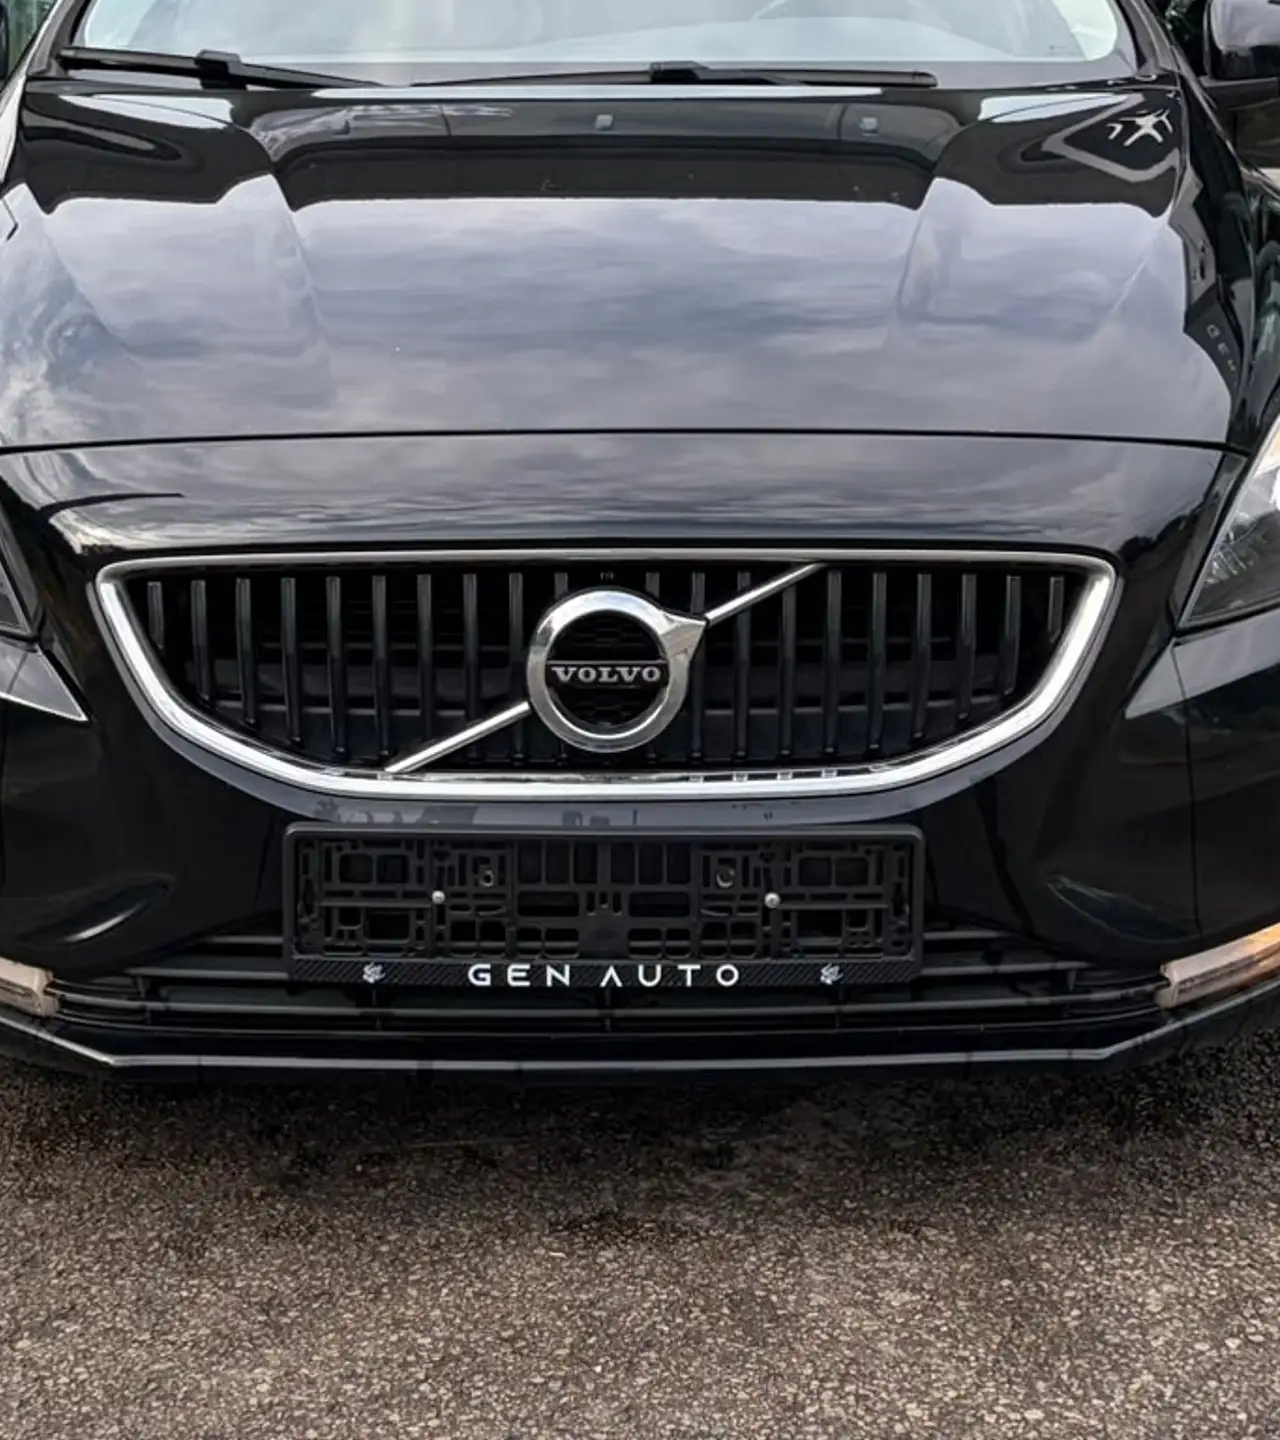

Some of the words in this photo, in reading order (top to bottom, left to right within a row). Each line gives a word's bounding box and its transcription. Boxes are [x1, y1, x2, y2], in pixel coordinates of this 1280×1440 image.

[551, 665, 662, 683] VOLVO
[466, 962, 571, 988] GEN
[599, 962, 741, 988] AUTO
